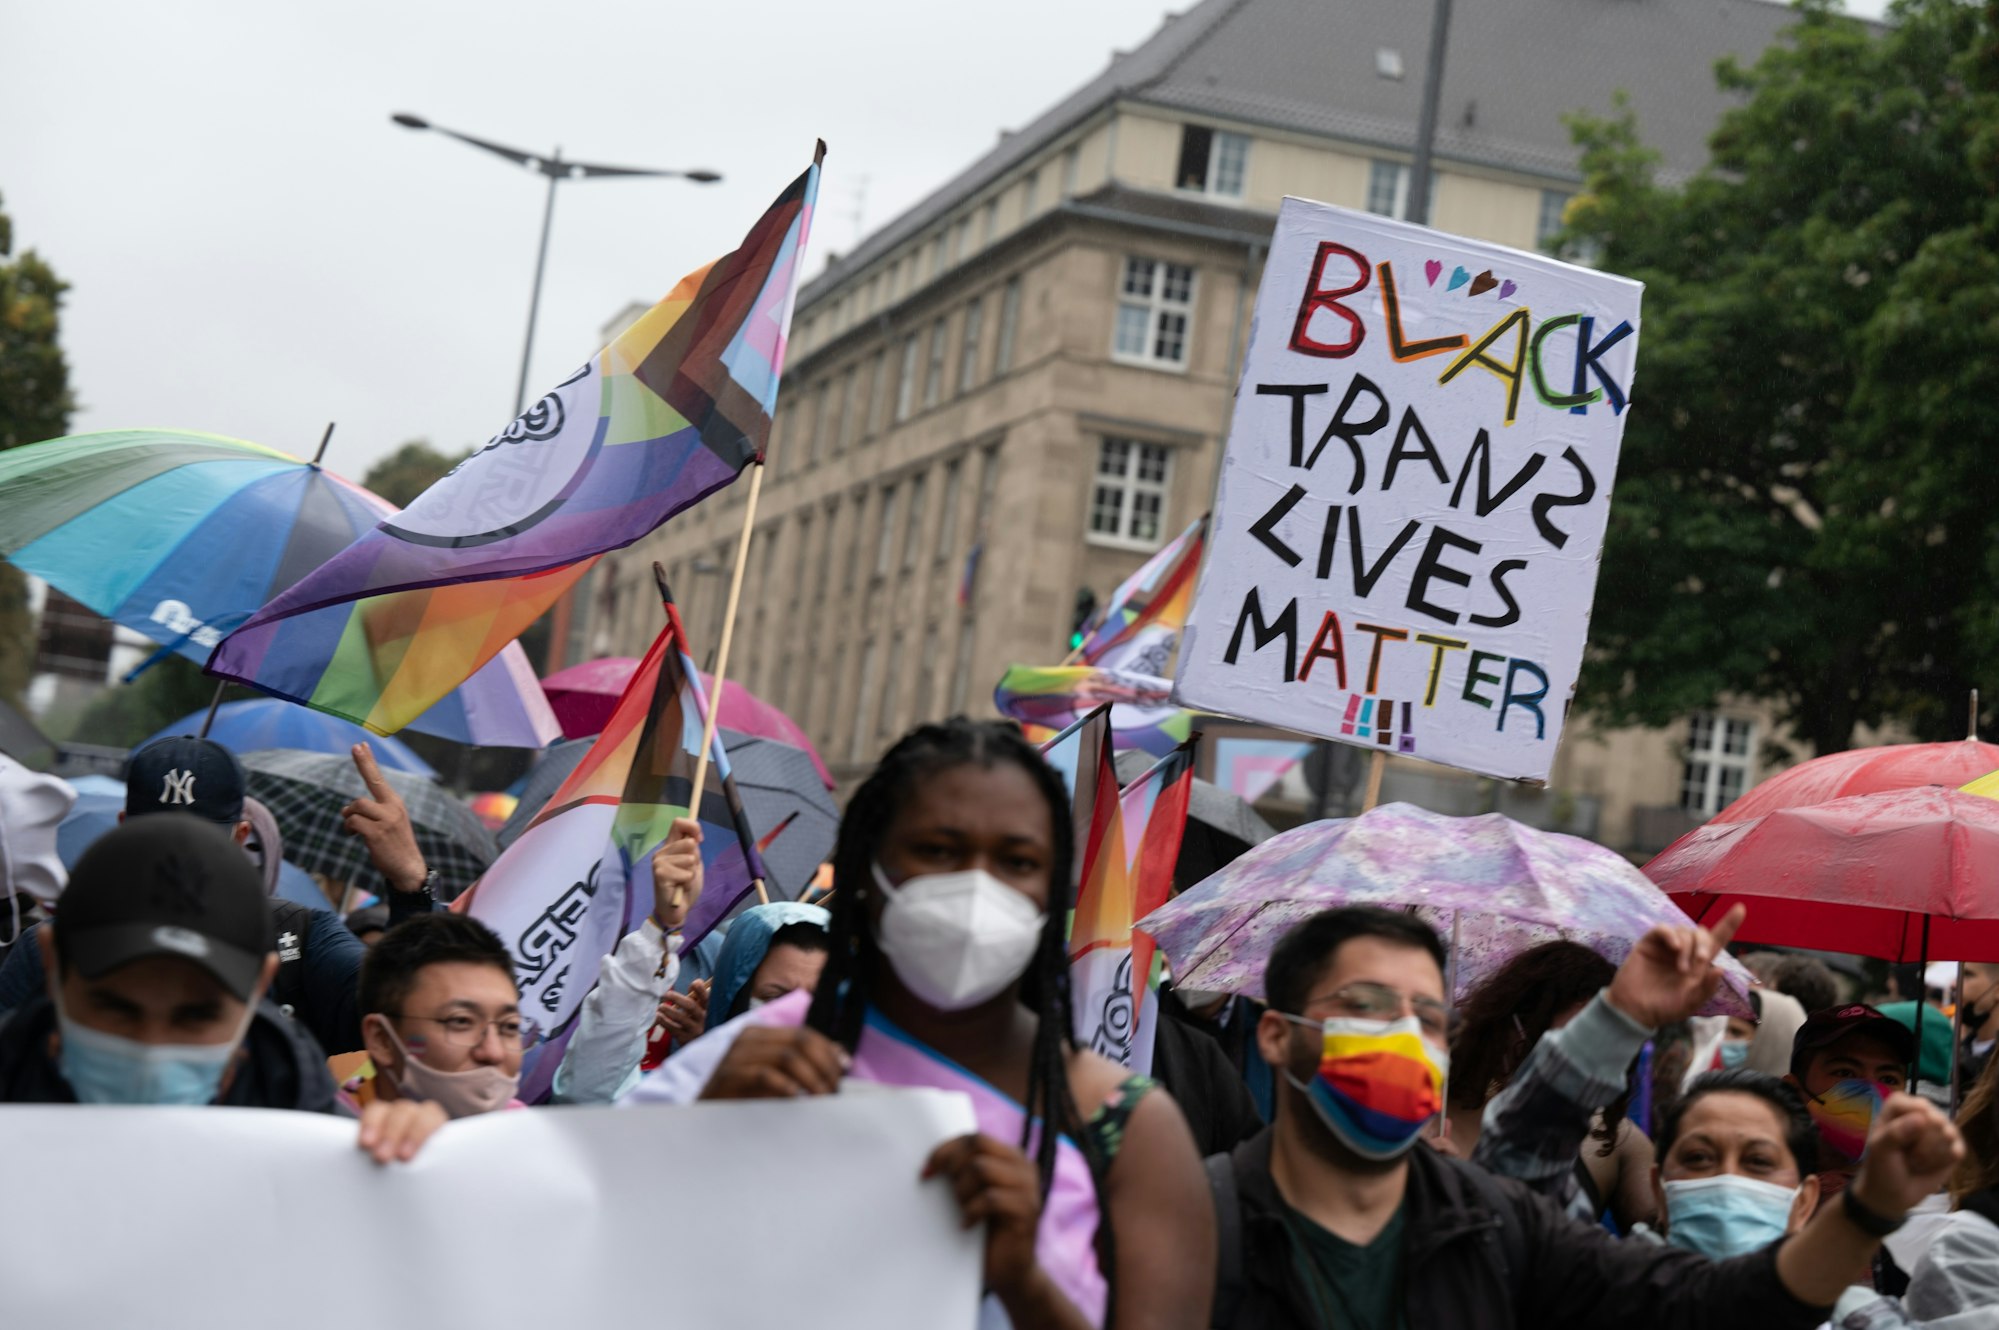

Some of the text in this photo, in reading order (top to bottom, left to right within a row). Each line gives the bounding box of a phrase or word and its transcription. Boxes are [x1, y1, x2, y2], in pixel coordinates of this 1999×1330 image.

[1287, 240, 1635, 427] BLACK
[1256, 372, 1597, 550] TRANS
[1248, 483, 1528, 628] LIVES
[1222, 586, 1550, 740] MATTER
[159, 768, 197, 805] NY
